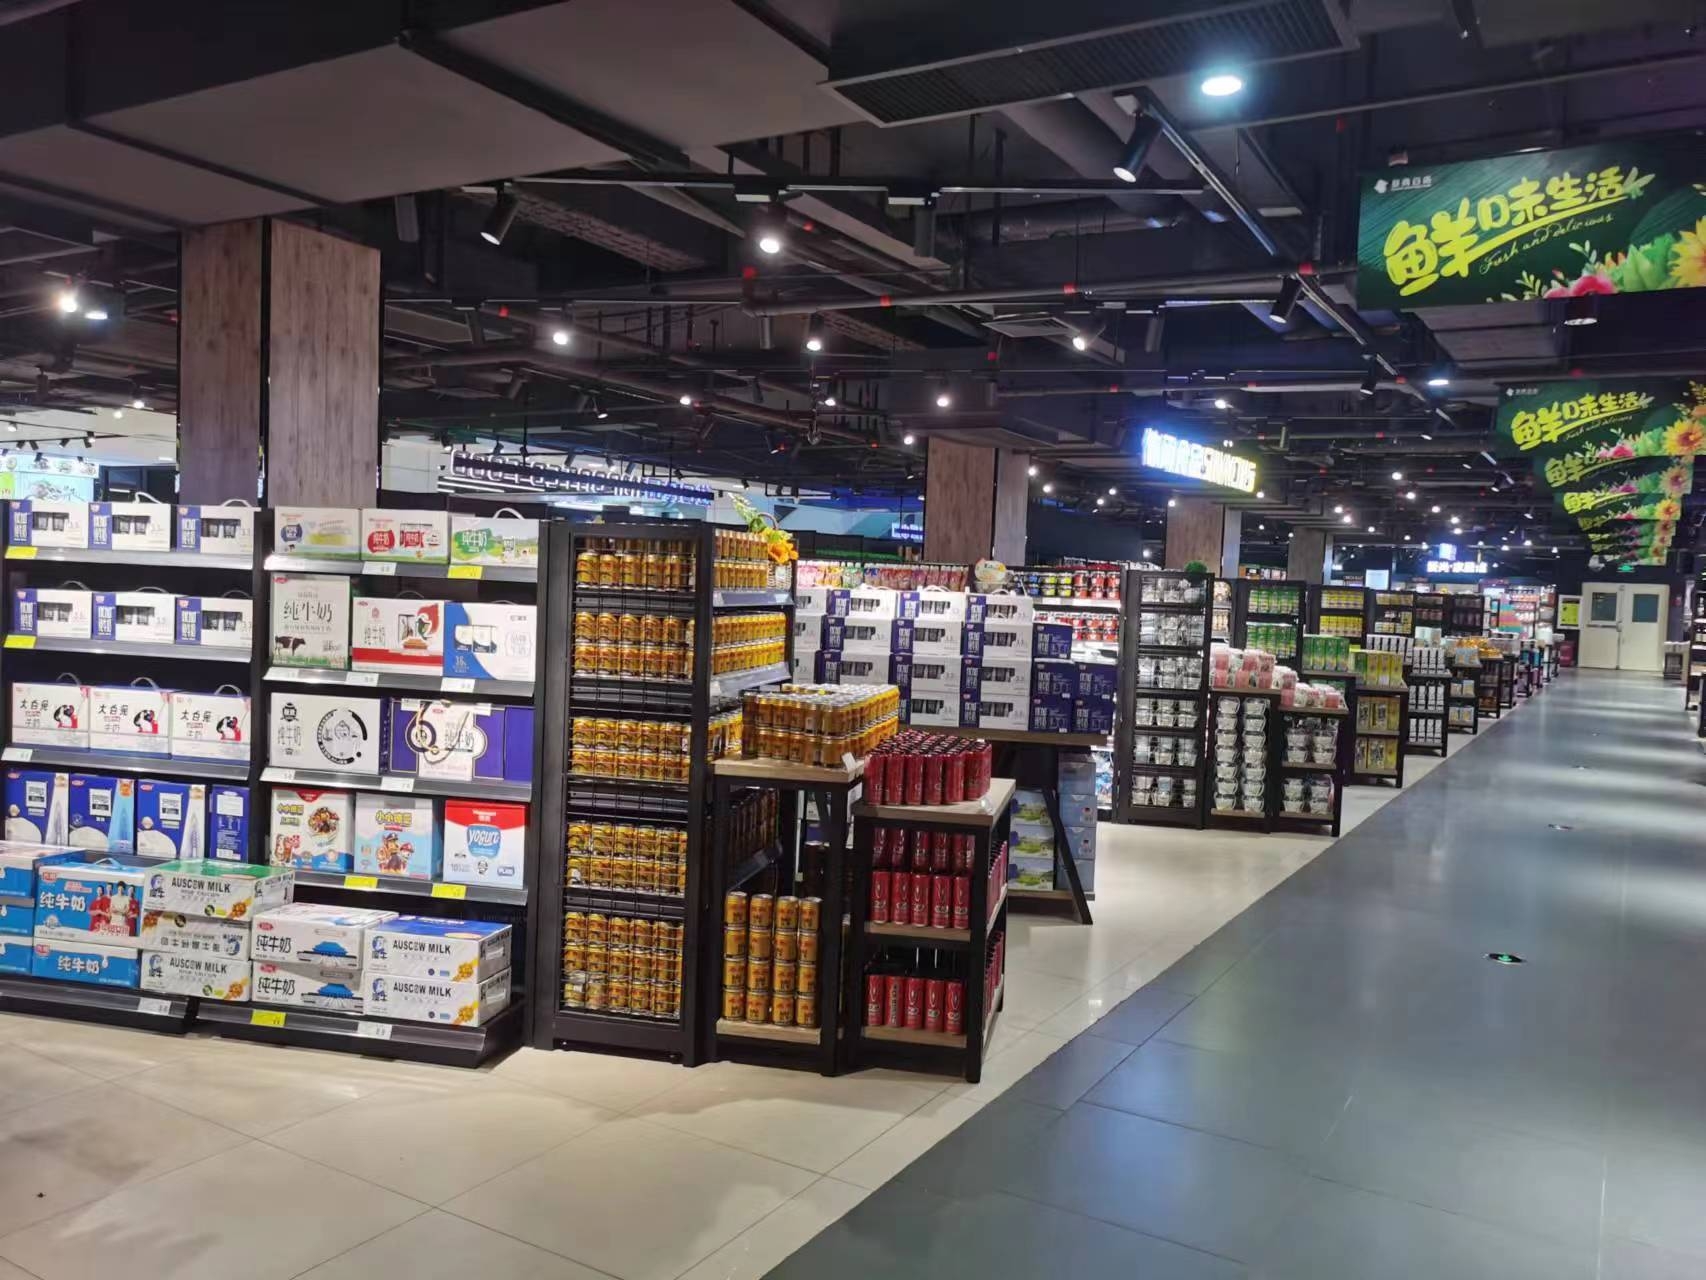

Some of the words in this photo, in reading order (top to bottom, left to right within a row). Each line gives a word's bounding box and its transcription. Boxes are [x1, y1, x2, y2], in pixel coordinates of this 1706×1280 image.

[1384, 166, 1627, 296] 鲜口味生活
[1523, 228, 1549, 250] and
[1511, 391, 1639, 451] 鲜口味生活
[283, 601, 333, 623] 纯牛奶
[172, 877, 205, 890] AUSCOW
[207, 881, 231, 893] MILK
[40, 891, 86, 912] 纯牛奶
[256, 935, 292, 953] 纯牛奶
[392, 940, 426, 952] AUSCOW
[428, 943, 451, 955] MILK
[58, 956, 99, 974] 纯牛奶
[170, 957, 203, 969] AUSCOW
[204, 962, 228, 974] MILK
[257, 977, 295, 995] 纯牛奶
[393, 982, 426, 994] AUSCOW
[428, 986, 452, 998] MILK
